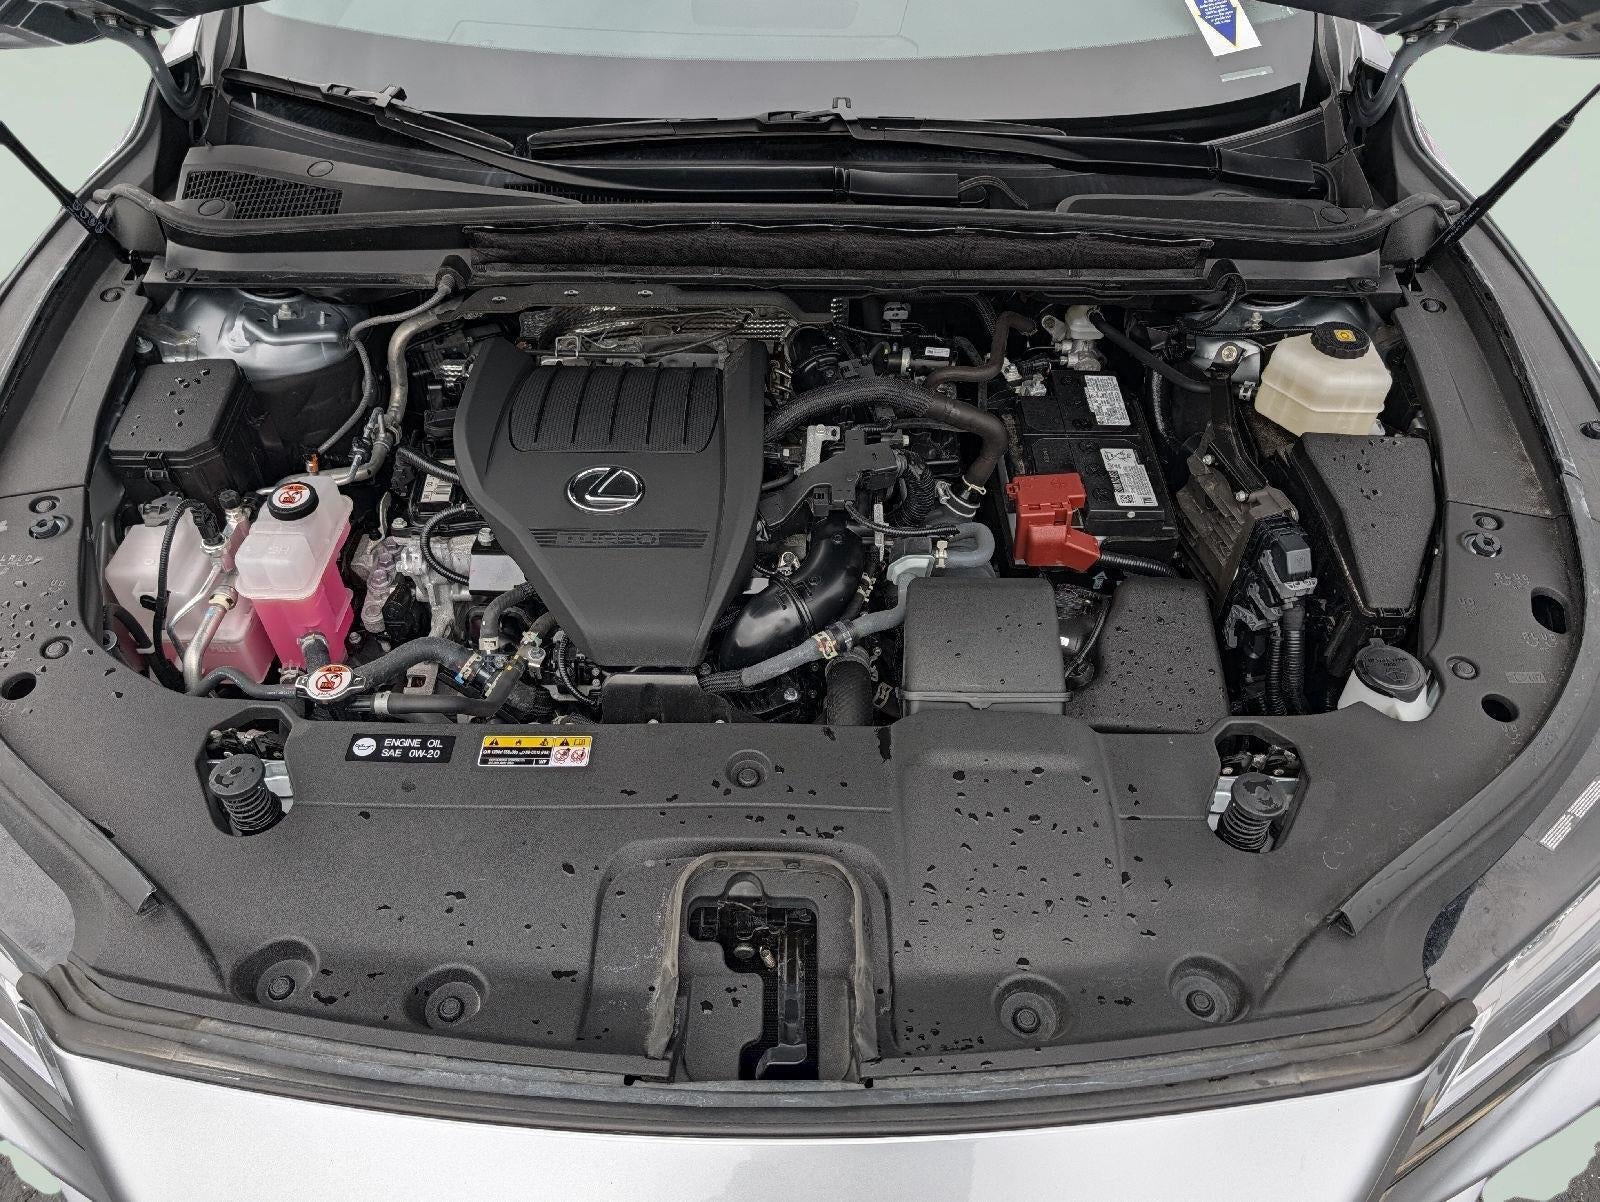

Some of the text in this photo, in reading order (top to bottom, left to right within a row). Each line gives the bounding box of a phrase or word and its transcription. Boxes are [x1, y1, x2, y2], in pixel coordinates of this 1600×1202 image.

[556, 532, 660, 546] TURBO
[384, 738, 443, 748] ENGINE OIL
[381, 748, 441, 758] SAE 0W-20
